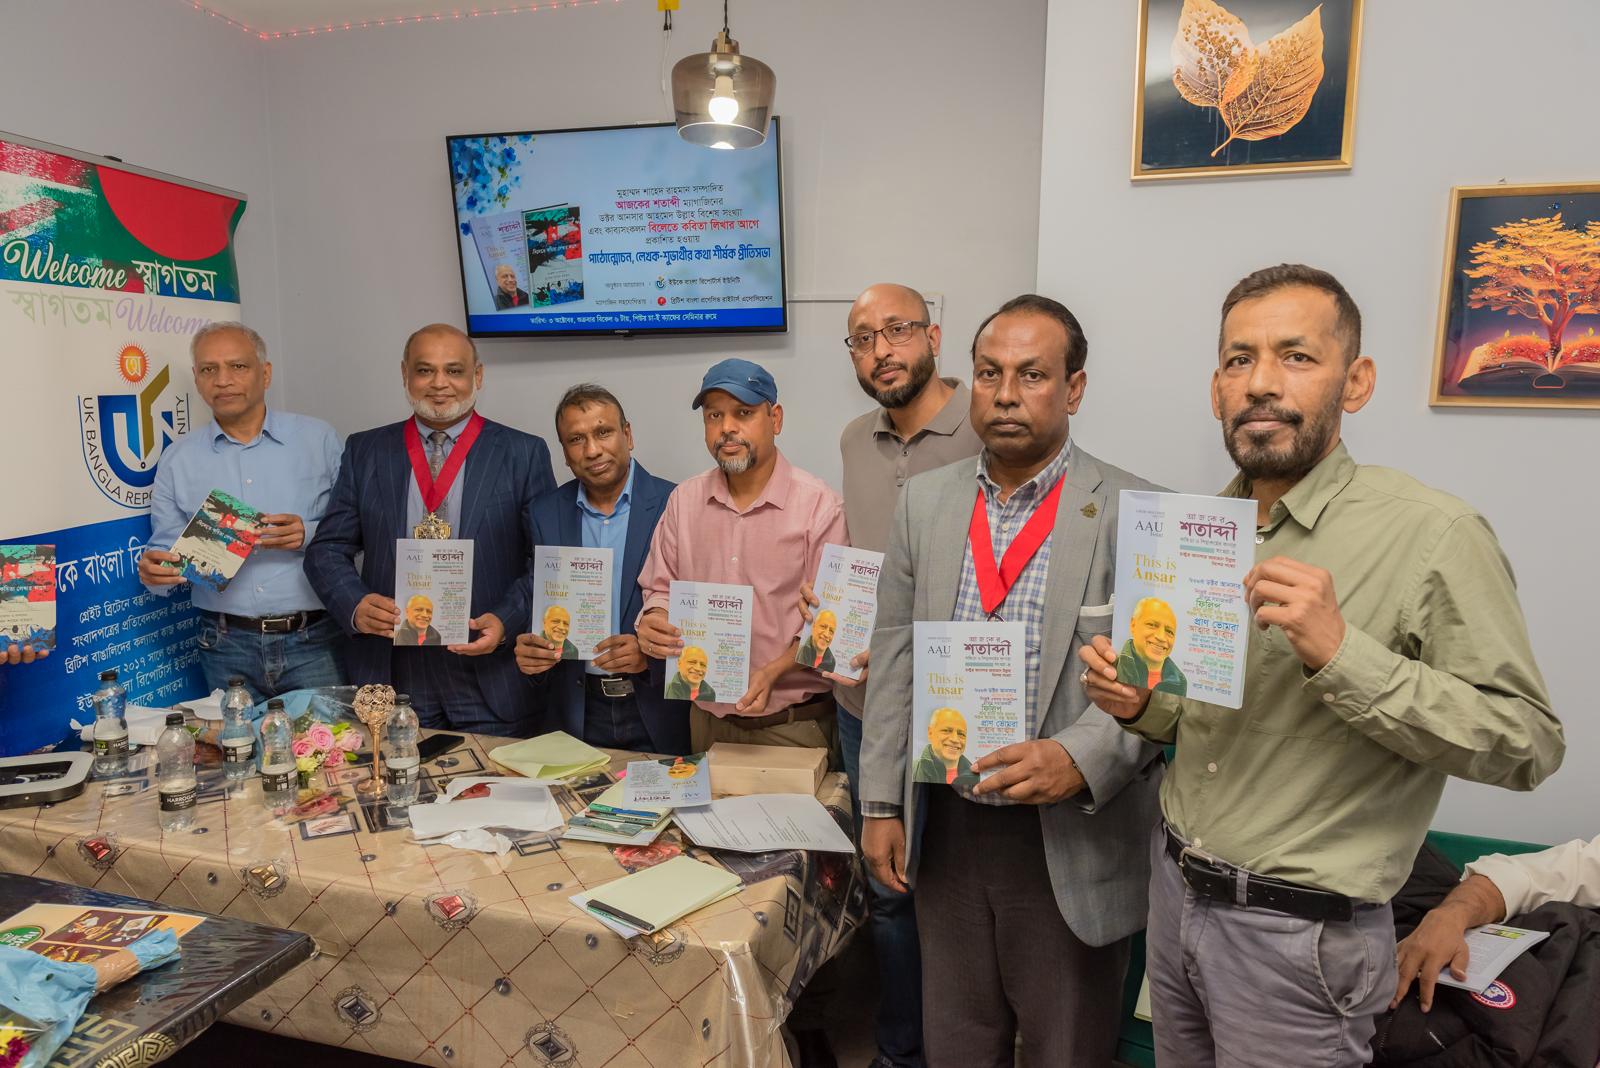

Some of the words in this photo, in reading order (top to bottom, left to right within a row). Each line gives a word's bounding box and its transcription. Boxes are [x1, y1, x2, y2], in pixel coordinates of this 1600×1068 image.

[615, 200, 650, 210] আজকের
[653, 196, 680, 208] শতাব্দী
[682, 196, 724, 207] ম্যাগাজিনের
[617, 212, 644, 221] আনসার
[646, 212, 674, 220] আহমেদ
[698, 208, 720, 218] বিশেষ
[722, 208, 743, 217] সংখ্যা
[648, 220, 680, 232] বিলেতে
[682, 220, 708, 231] কবিতা
[710, 218, 736, 231] লিখার
[738, 219, 760, 230] আগে
[646, 234, 674, 244] প্রকাশিত
[694, 249, 712, 260] কথা
[712, 244, 736, 260] শীর্ষক
[3, 239, 129, 289] Welcome
[131, 259, 218, 298] স্বাগতম
[6, 289, 114, 330] স্বাগতম
[82, 397, 95, 423] UK
[85, 430, 121, 499] BANGLA
[1135, 520, 1164, 532] AAU
[1179, 521, 1238, 541] শতাব্দী
[432, 551, 465, 562] শতাব্দী
[1133, 553, 1161, 568] This
[82, 548, 124, 585] বাংলা
[570, 560, 604, 572] শতাব্দী
[850, 562, 880, 578] শতাব্দী
[1132, 567, 1176, 584] Ansar
[708, 598, 743, 610] শতাব্দী
[79, 604, 101, 624] গ্রেইট
[72, 622, 120, 648] সংবাদপত্রের
[122, 606, 168, 630] প্রতিবেদকদের
[65, 654, 89, 674] ব্রিটিশ
[91, 640, 131, 662] বাঙালিদের
[133, 629, 159, 648] কল্যাণে
[928, 645, 952, 654] AAU
[964, 640, 1012, 656] শতাব্দী
[124, 656, 146, 672] ২০১৭
[148, 648, 164, 663] সালে
[136, 661, 172, 688] রিপোর্টার্স
[928, 672, 952, 684] This
[156, 678, 183, 698] স্বাগতম
[928, 684, 964, 696] Ansar
